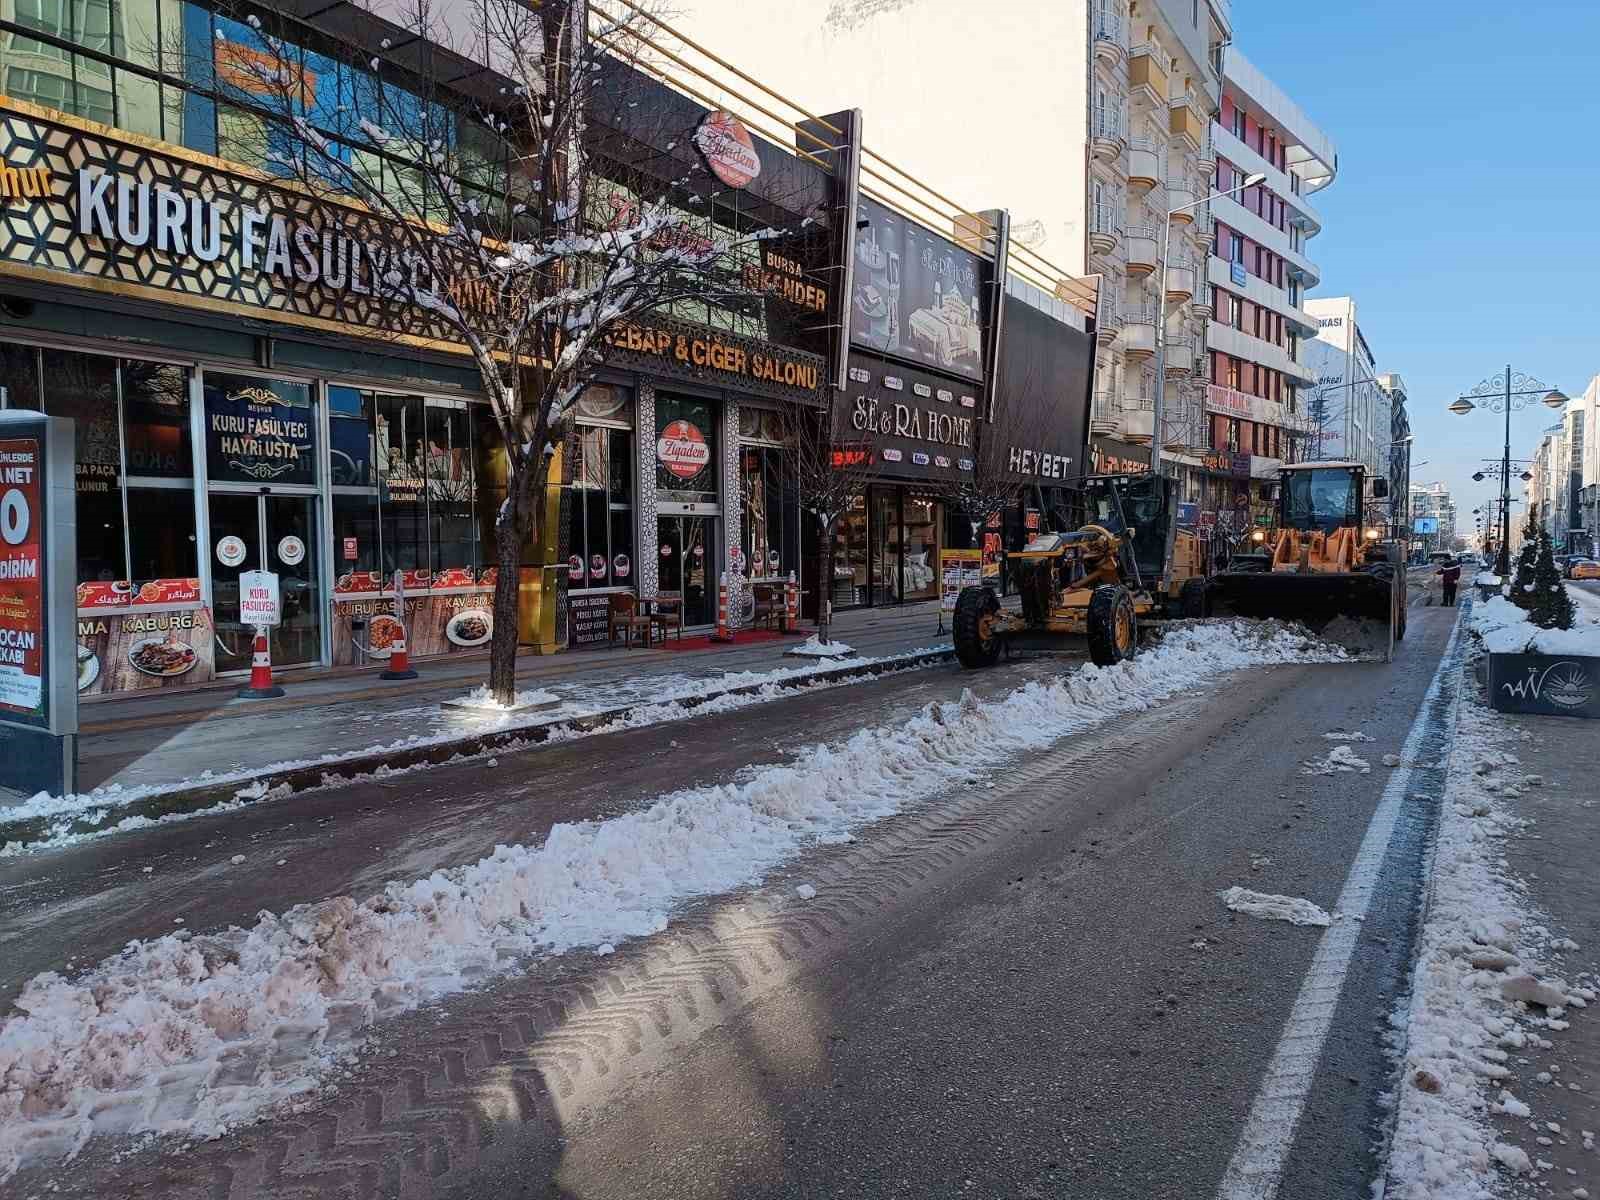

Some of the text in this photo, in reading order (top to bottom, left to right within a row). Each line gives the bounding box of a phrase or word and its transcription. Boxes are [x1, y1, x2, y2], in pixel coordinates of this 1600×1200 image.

[78, 168, 221, 262] KURU
[767, 251, 802, 278] BURSA
[675, 335, 688, 361] &
[752, 353, 817, 391] SALONU
[212, 414, 245, 433] KURU
[881, 411, 892, 434] &
[894, 403, 922, 439] RA
[927, 410, 971, 447] HOME
[265, 441, 299, 459] USTA
[1009, 447, 1072, 479] HEYBET
[336, 603, 375, 616] KURU
[375, 600, 423, 615] FASLYE
[123, 615, 202, 633] KABURGA
[0, 647, 24, 664] KABI
